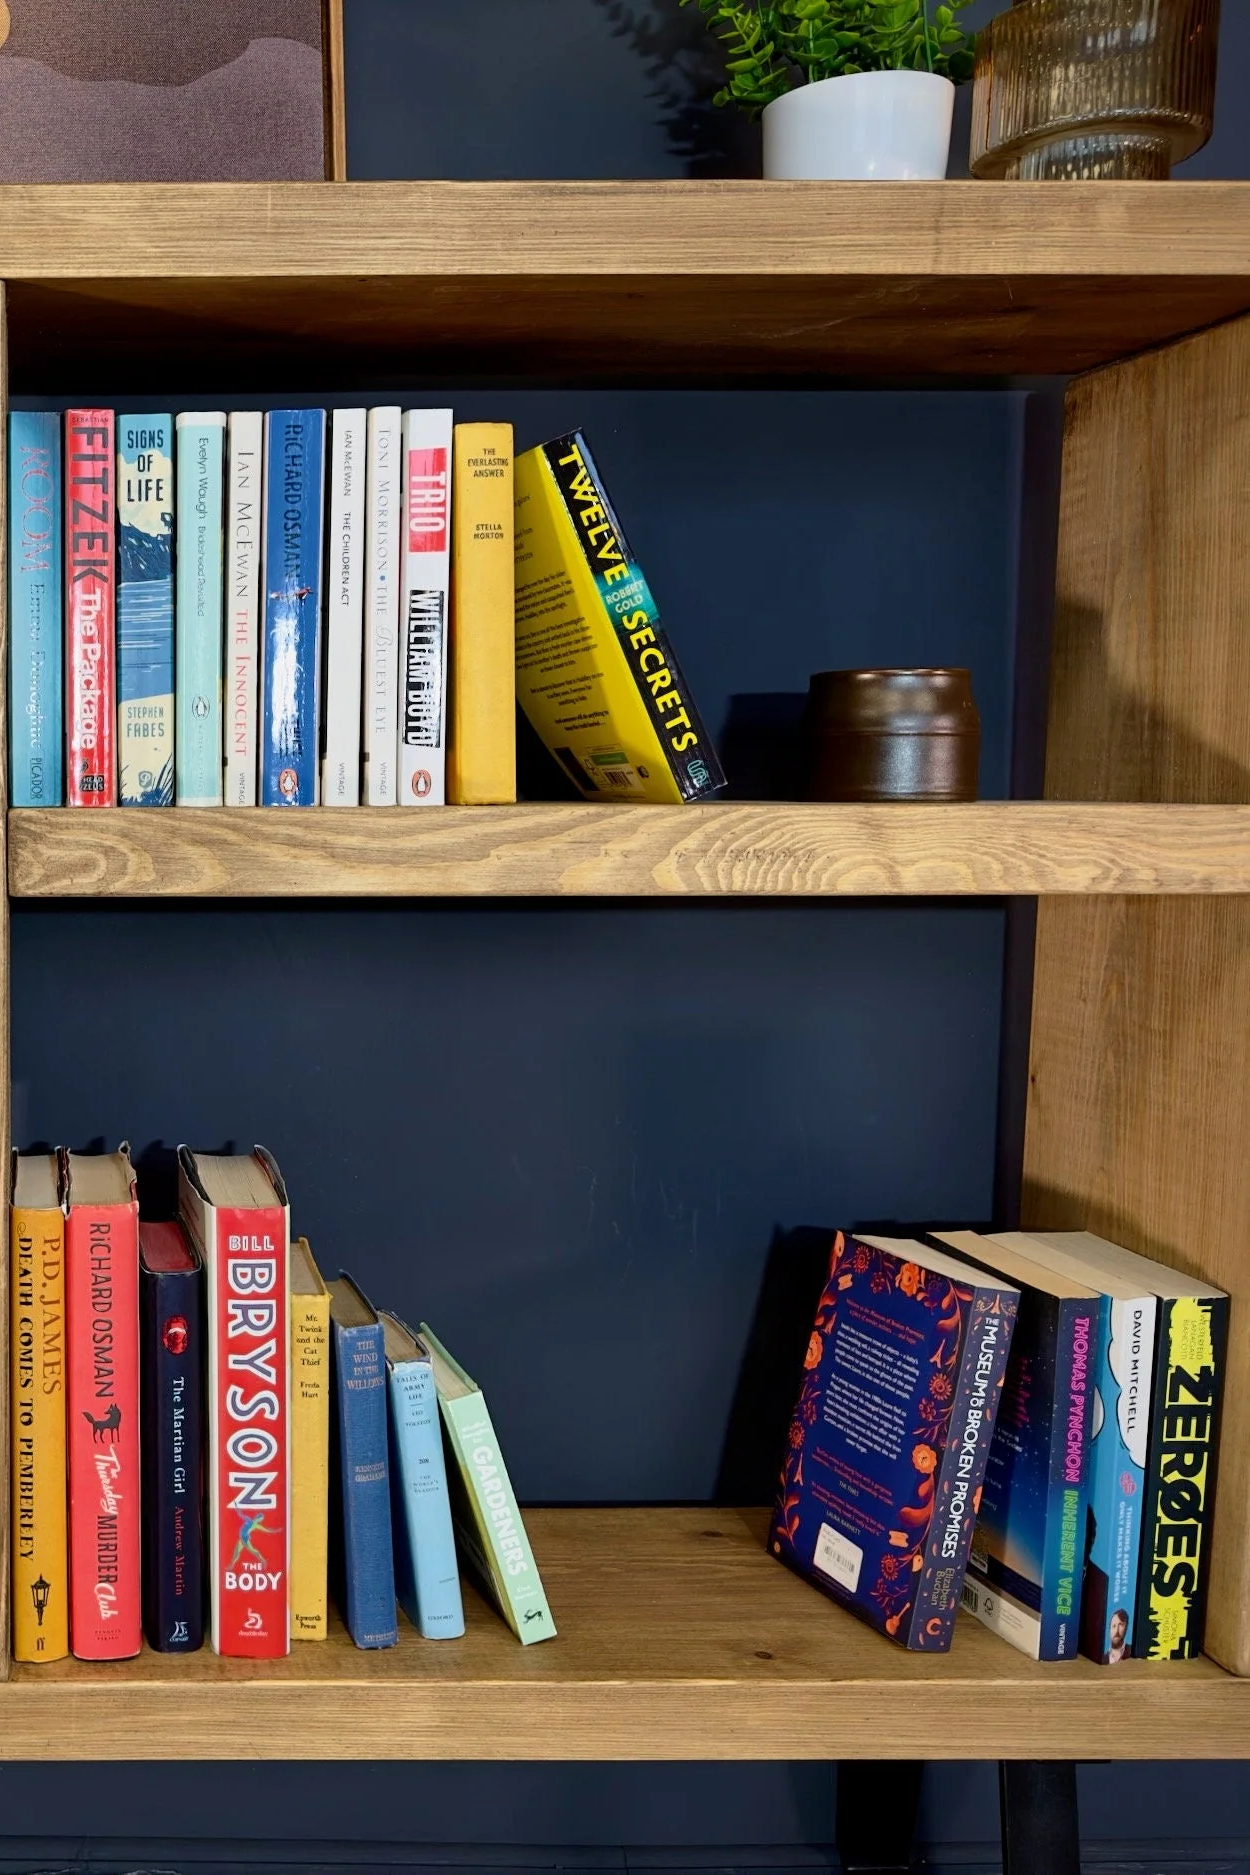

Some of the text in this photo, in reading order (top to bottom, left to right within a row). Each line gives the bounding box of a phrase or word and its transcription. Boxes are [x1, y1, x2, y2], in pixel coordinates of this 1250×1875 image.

[127, 429, 164, 449] SIGNS
[483, 448, 496, 456] THE
[137, 454, 154, 472] OF
[195, 437, 209, 474] Evelyn
[473, 469, 505, 478] ANSWER
[72, 427, 109, 584] FITZEK
[127, 479, 164, 502] LIFE
[195, 476, 209, 520] Waugh
[473, 532, 504, 540] MORTON
[476, 523, 502, 531] STELLA
[283, 509, 302, 580] OSMAN
[558, 443, 631, 586] TWELVE
[621, 610, 699, 752] SECRETS
[605, 580, 645, 604] ROBERT
[615, 595, 644, 614] GOLD
[20, 446, 54, 800] ROOM PICADOR
[80, 587, 102, 637] The
[338, 430, 353, 797] IAN THE CHILDREN ACT VINTAGE
[375, 427, 394, 797] TONI MORRISON THE BLUEST EYE VINTAGE
[406, 471, 446, 746] TRIO WILLIAM BOYD
[235, 450, 254, 805] IAN THE INNOCENT VINTAGE
[74, 641, 102, 750] Package
[127, 706, 164, 718] STEPHEN
[126, 722, 165, 737] FABES
[229, 1234, 275, 1252] BILL
[40, 1236, 62, 1396] P.D. JAMES
[299, 1325, 323, 1333] Twink
[305, 1314, 318, 1322] Mr.
[985, 1317, 1000, 1326] THE
[296, 1336, 326, 1344] and the
[303, 1346, 318, 1355] Cat
[356, 1340, 375, 1351] THE
[91, 1317, 115, 1398] OSMAN
[300, 1358, 322, 1367] Thief
[353, 1352, 378, 1364] WIND
[353, 1364, 379, 1376] IN THE
[971, 1325, 999, 1398] MUSEUM
[1126, 1309, 1143, 1434] DAVID MITCHELL
[226, 1258, 280, 1510] BRYSON
[300, 1380, 320, 1389] Freda
[301, 1390, 319, 1399] Hurt
[346, 1376, 384, 1390] WILLOWS
[403, 1383, 426, 1392] ARMY
[18, 1237, 35, 1561] DEATH COMES TO PEMBERLEY
[970, 1396, 987, 1408] OF
[94, 1445, 123, 1515] Thursday
[173, 1376, 186, 1597] The Martian Girl Andrew Martin
[940, 1409, 985, 1559] BROKEN PROMISES
[1057, 1317, 1090, 1655] THOMAS PYNCHON INHERENT VICE VINTAGE
[472, 1446, 529, 1576] GARDENERS
[1117, 1501, 1126, 1525] ONLY
[1115, 1528, 1124, 1560] MAKES
[1123, 1506, 1133, 1552] THINKING
[96, 1514, 119, 1584] MURDER
[224, 1570, 283, 1591] BODY
[241, 1561, 263, 1571] THE
[1121, 1553, 1131, 1584] ABOUT
[94, 1582, 122, 1621] Club
[929, 1570, 946, 1605] Buchan
[937, 1567, 956, 1611] Elizabeth
